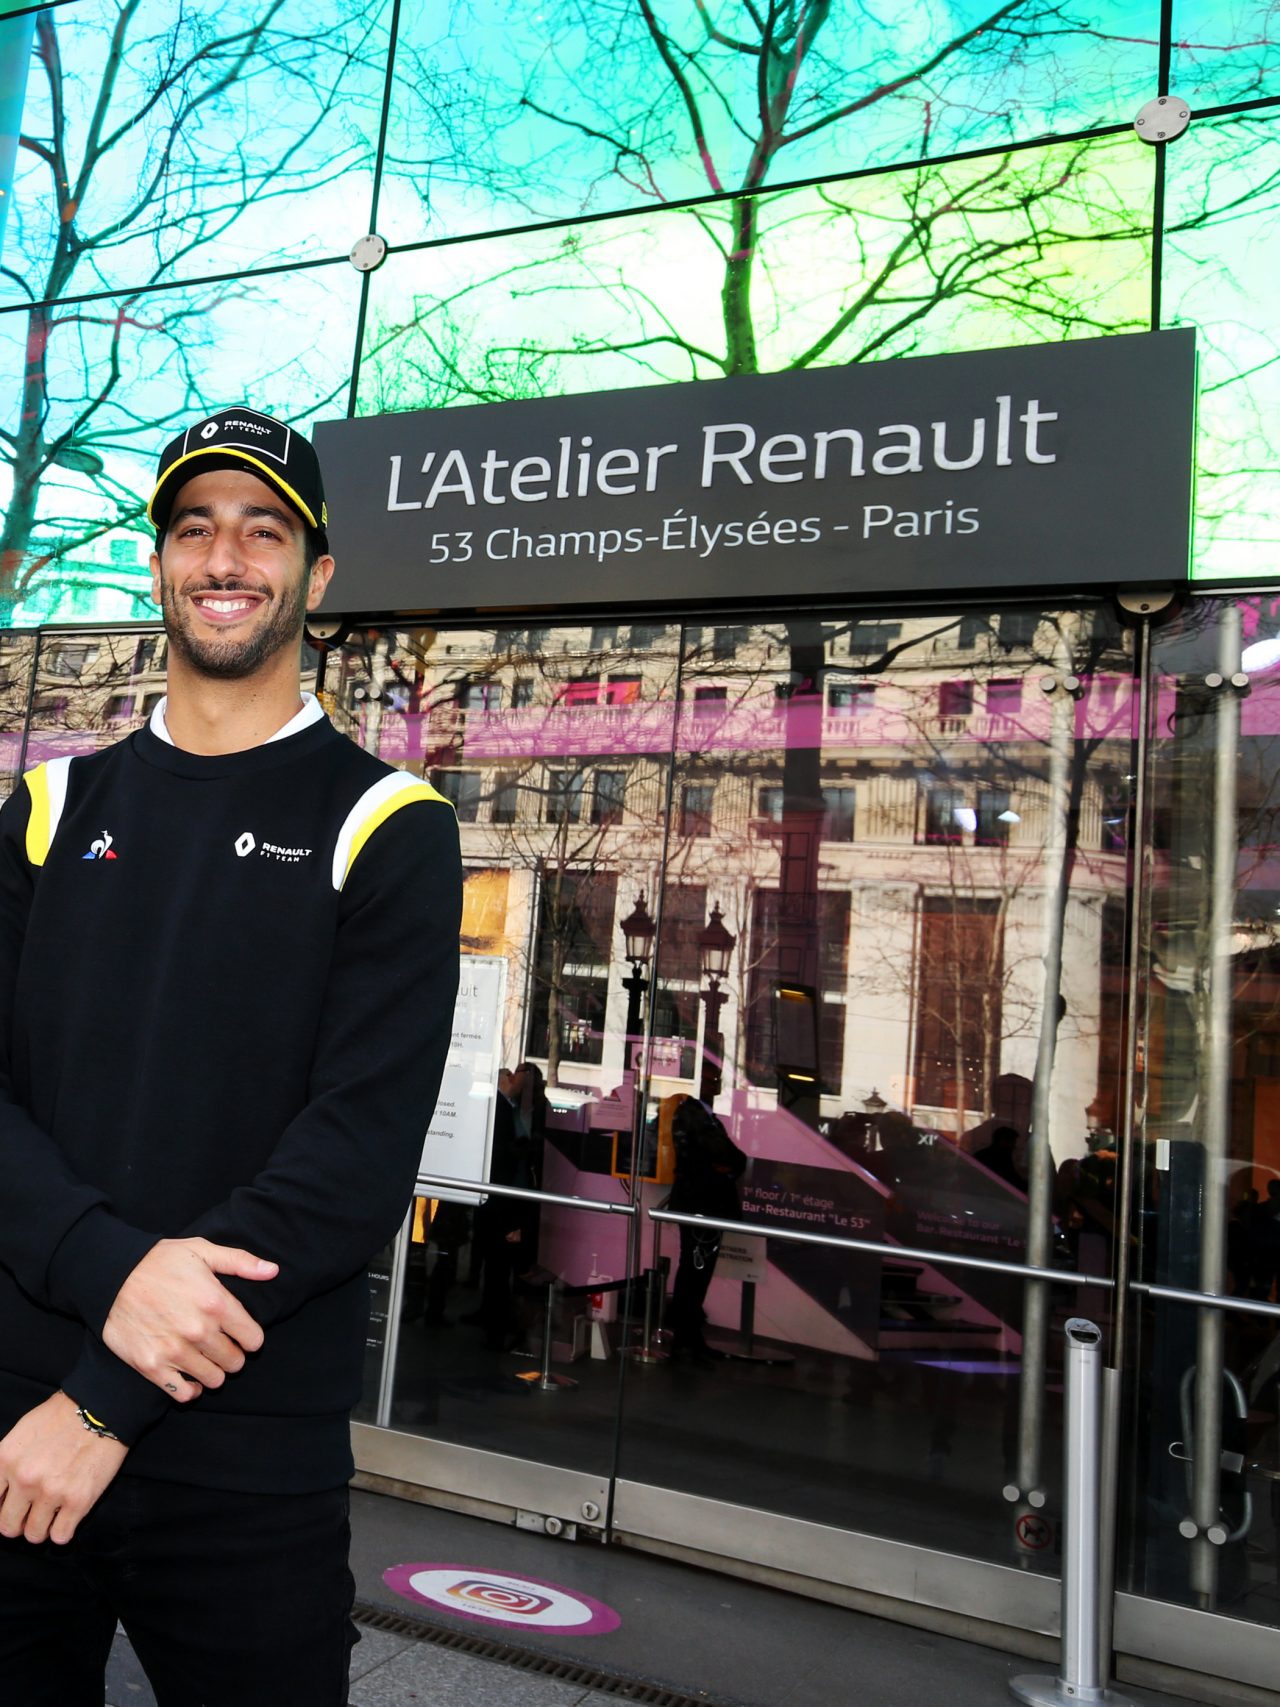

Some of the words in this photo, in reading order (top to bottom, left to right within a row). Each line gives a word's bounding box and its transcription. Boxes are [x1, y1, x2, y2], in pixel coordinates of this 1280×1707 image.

[224, 420, 272, 435] RENAULT
[239, 426, 263, 436] TEAM
[386, 436, 677, 513] L'Atelier
[700, 396, 1058, 488] Renault
[429, 532, 473, 564] 53
[486, 508, 820, 564] Champs-Élysées
[863, 499, 980, 539] Paris
[260, 850, 270, 858] F1
[276, 855, 300, 863] TEAM
[262, 842, 312, 857] RENAULT
[755, 1187, 780, 1201] floor
[803, 1194, 835, 1210] étage
[742, 1201, 826, 1223] Bar-Restaurant
